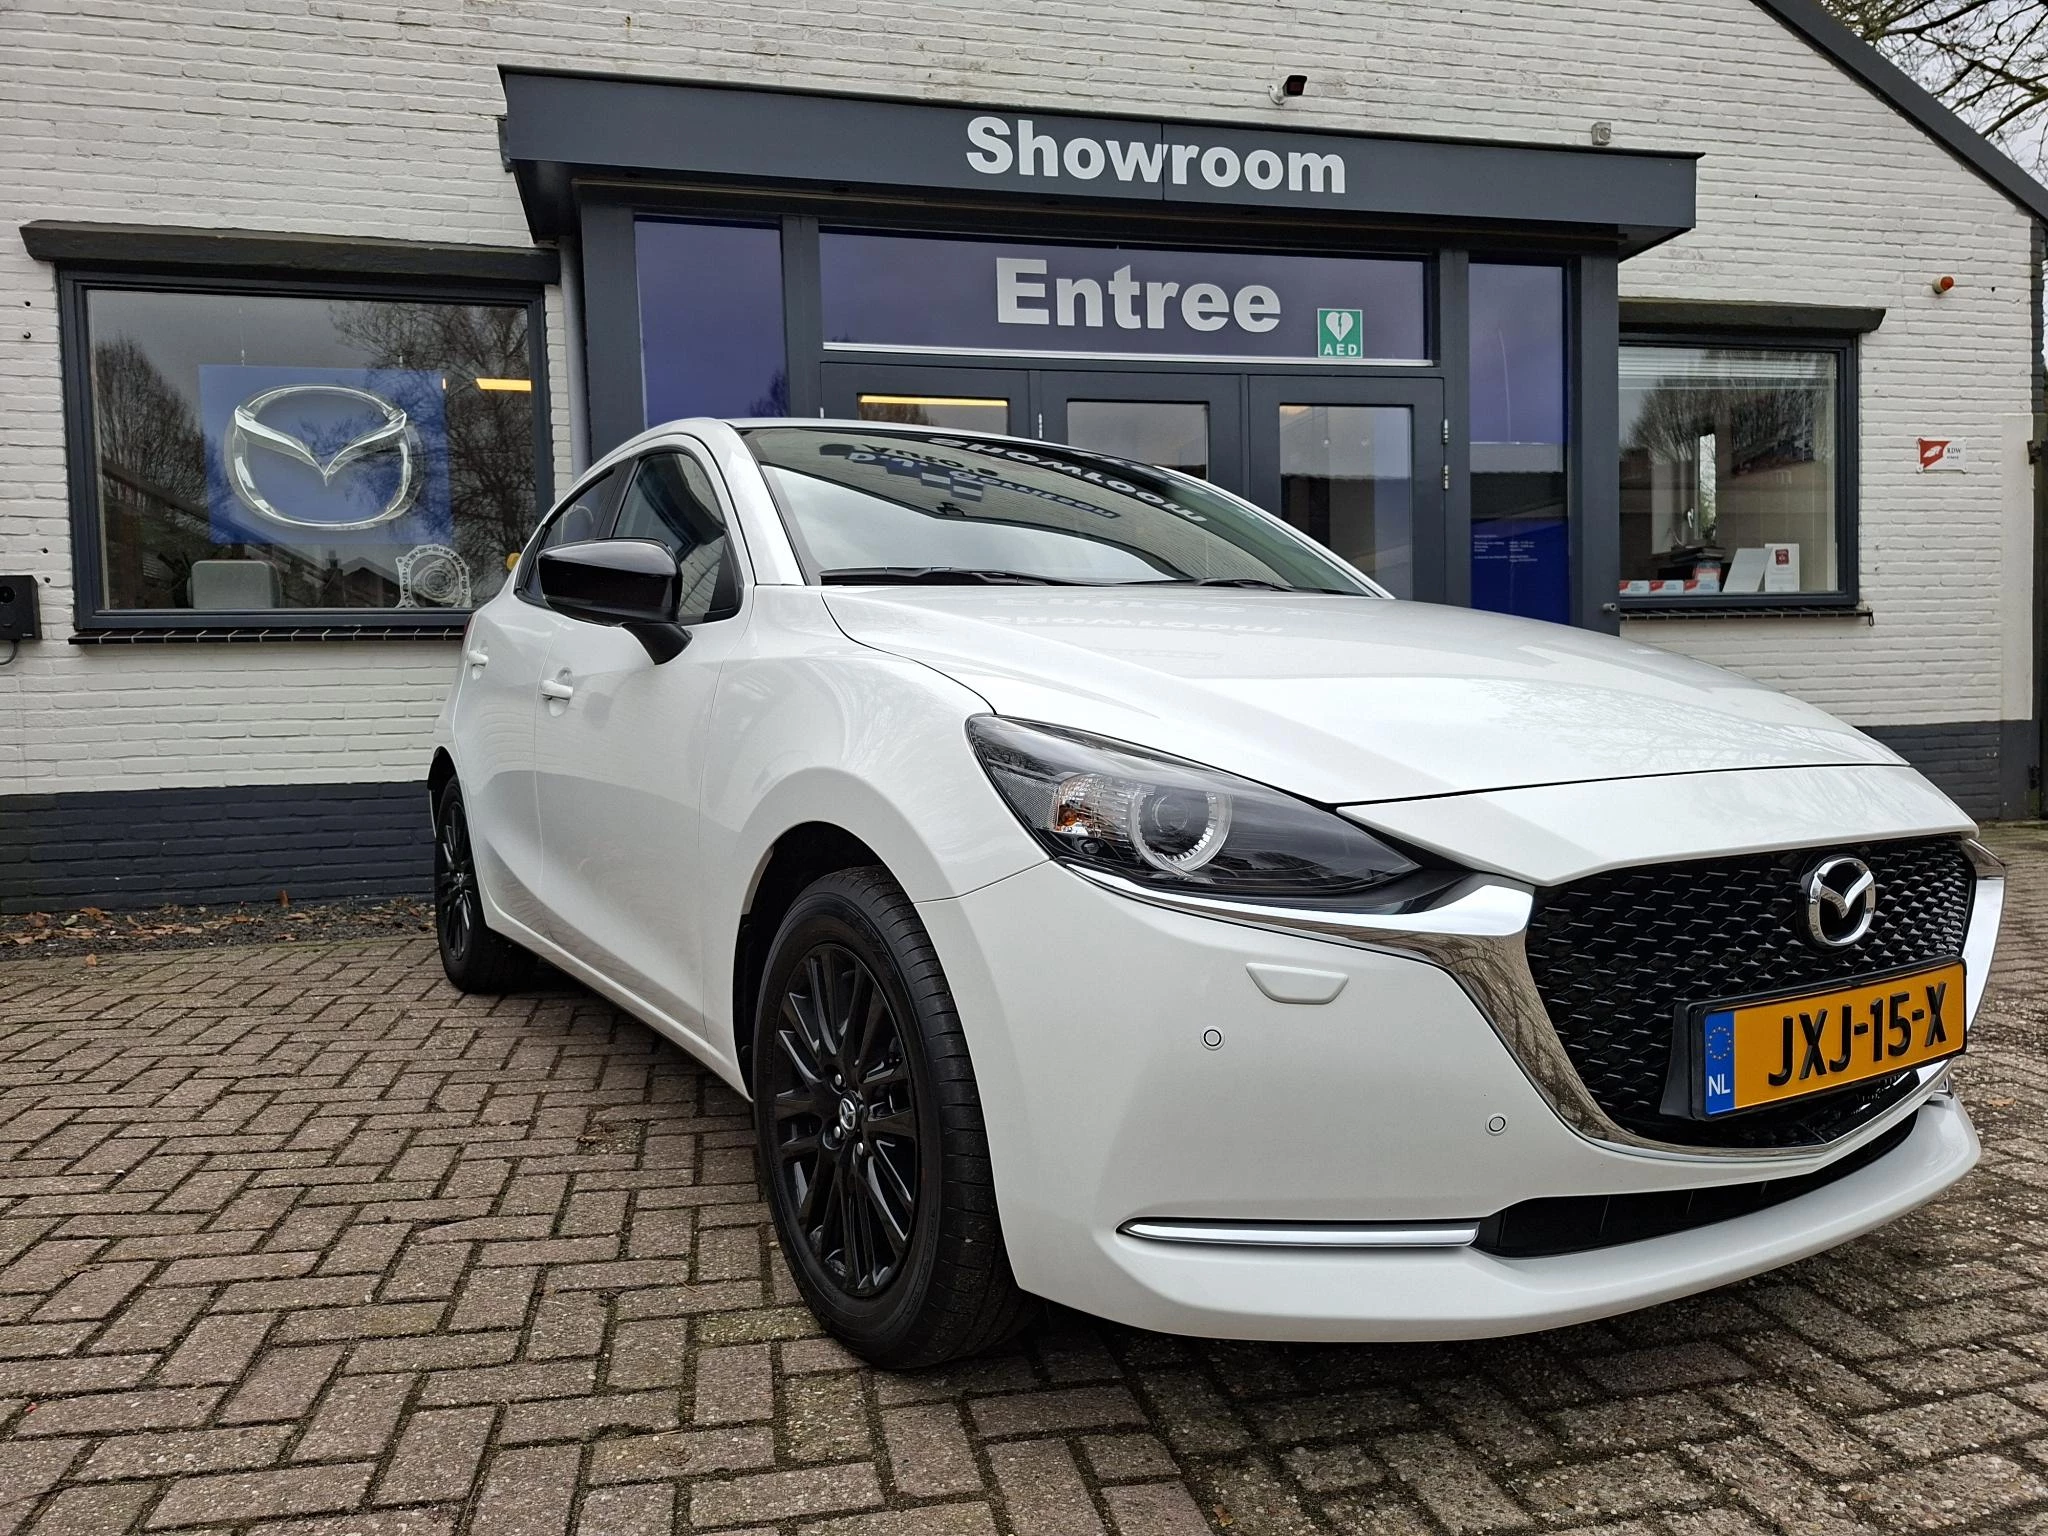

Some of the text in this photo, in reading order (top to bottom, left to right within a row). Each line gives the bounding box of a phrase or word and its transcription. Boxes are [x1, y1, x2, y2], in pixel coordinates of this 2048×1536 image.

[966, 116, 1345, 194] Showroom
[996, 257, 1282, 333] Entree
[1323, 343, 1358, 356] AED
[1768, 981, 1947, 1087] JXJ-15-X
[1708, 1075, 1731, 1098] NL
